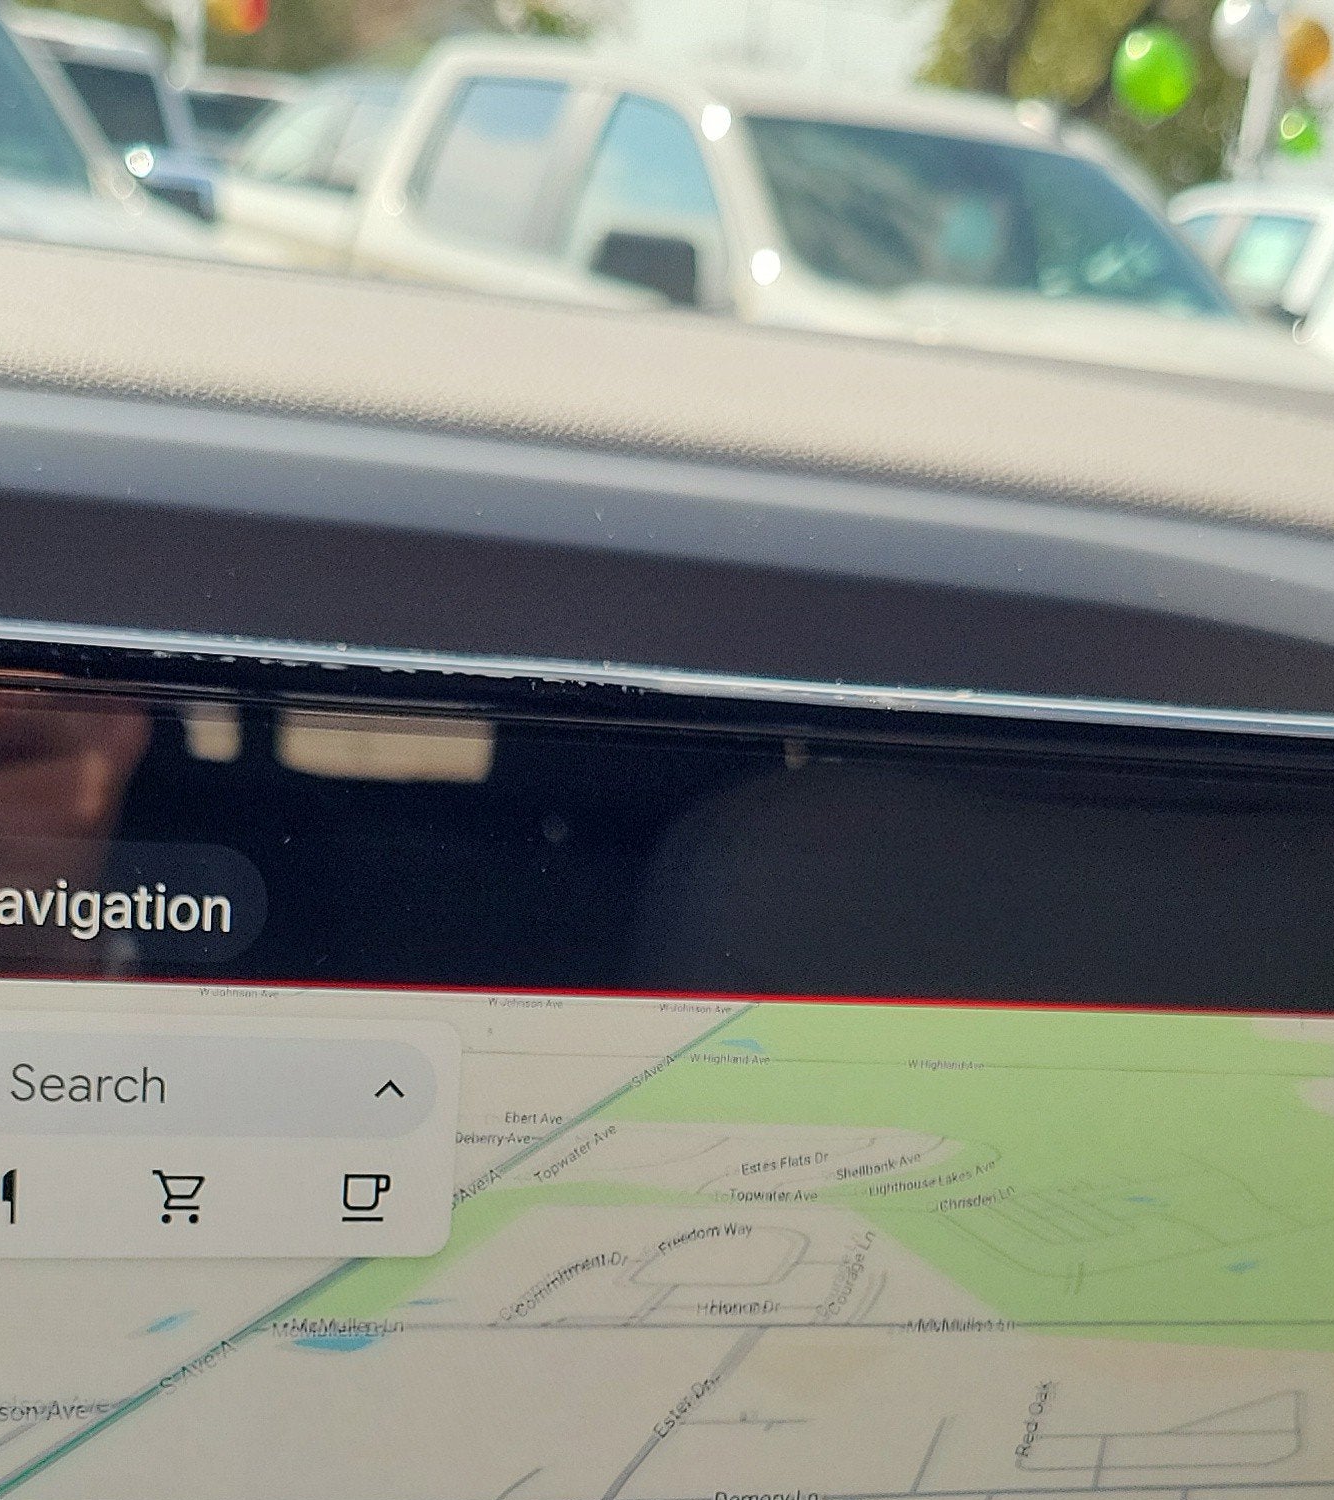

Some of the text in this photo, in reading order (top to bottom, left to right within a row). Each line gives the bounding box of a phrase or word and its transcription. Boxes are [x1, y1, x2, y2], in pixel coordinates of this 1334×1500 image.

[499, 998, 543, 1009] Johnson
[545, 999, 564, 1009] Ave
[690, 1053, 771, 1066] W Highland Ave
[908, 1058, 919, 1069] W
[920, 1058, 966, 1071] Highland
[631, 1053, 676, 1089] S Ave A
[11, 1062, 165, 1103] Search
[505, 1111, 563, 1126] Ebert Ave
[455, 1131, 532, 1146] Deberry Ave
[533, 1123, 618, 1184] Topwater Ave
[899, 1152, 921, 1168] Ave
[741, 1151, 829, 1176] Estes Flats Dr
[456, 1168, 504, 1203] Ave A
[868, 1158, 997, 1198] Lighthouse Lakes Ave
[729, 1187, 819, 1203] Topwater Ave
[998, 1184, 1017, 1200] Ln
[657, 1221, 753, 1257] Freedom Way
[861, 1229, 876, 1252] Ln
[610, 1250, 628, 1268] Dr
[762, 1300, 782, 1315] Dr
[45, 1400, 89, 1422] Ave
